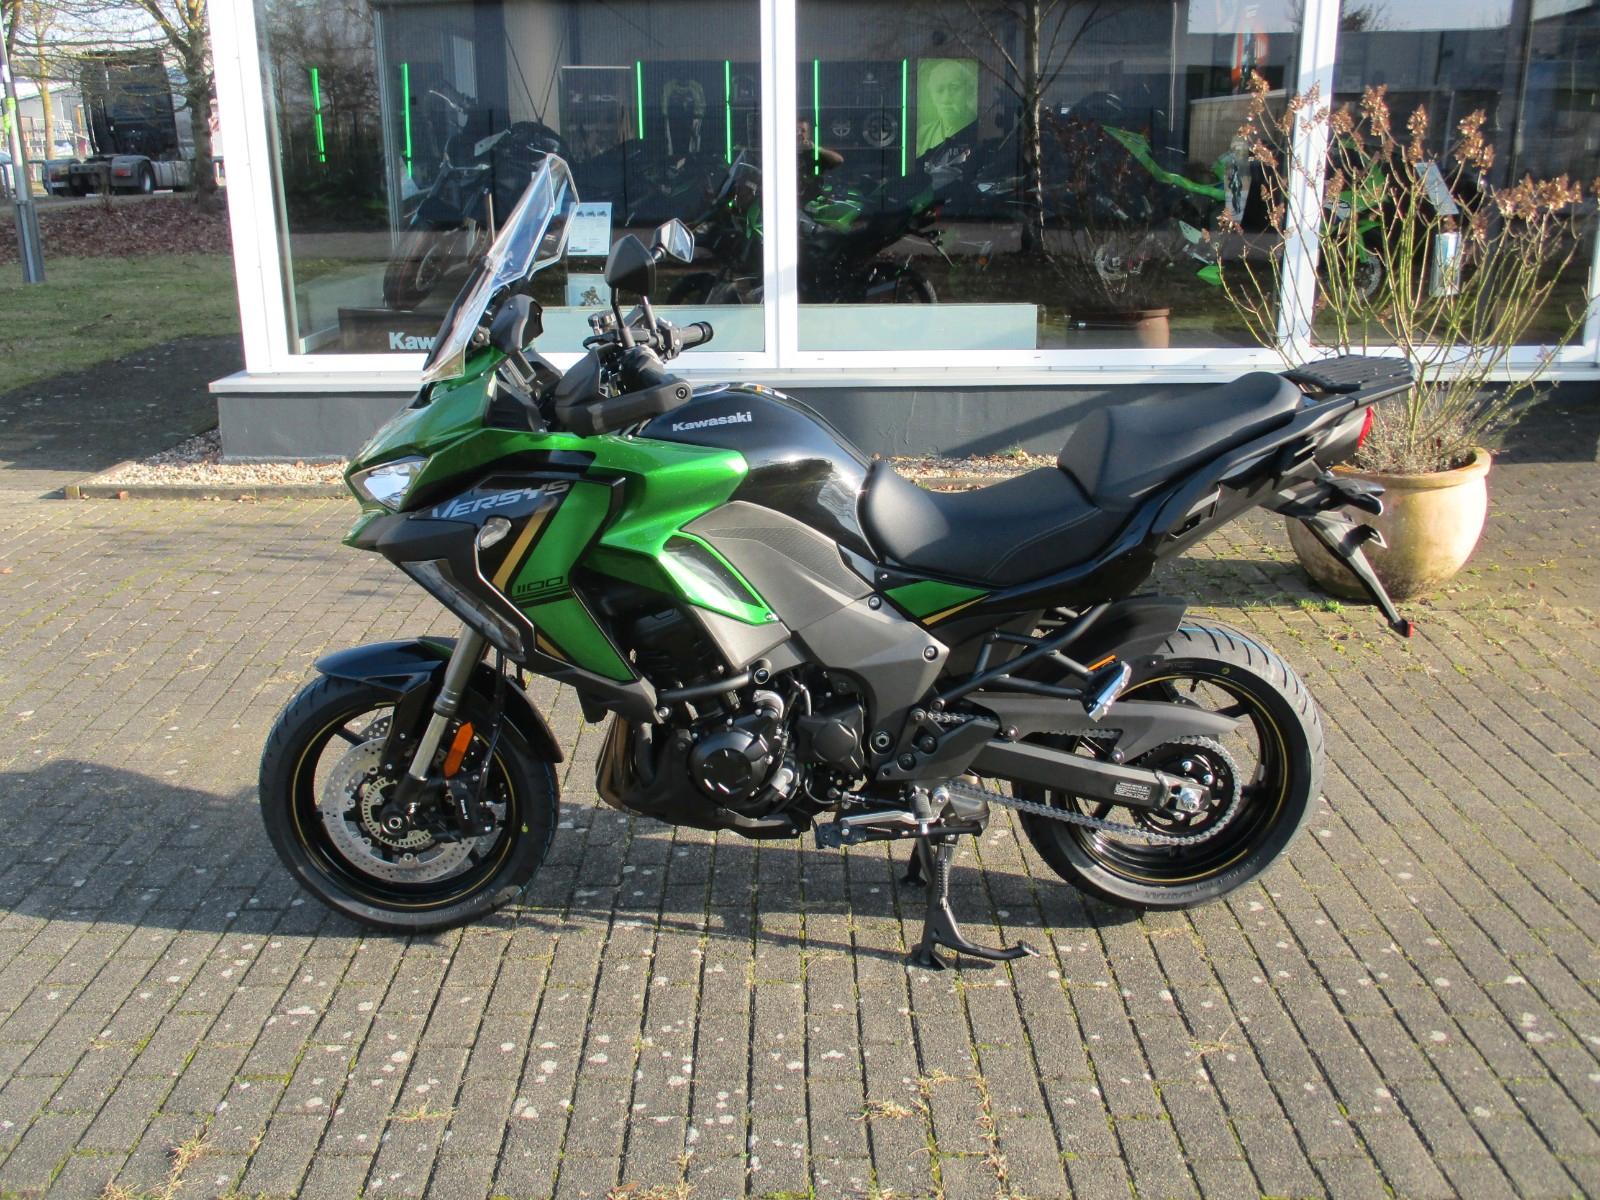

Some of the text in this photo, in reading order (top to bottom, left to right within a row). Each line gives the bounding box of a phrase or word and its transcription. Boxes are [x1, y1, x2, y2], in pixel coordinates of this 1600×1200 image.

[388, 332, 437, 350] Kaw
[672, 411, 753, 432] Kawasaki
[431, 480, 571, 519] VERSYS
[517, 576, 564, 594] 1100
